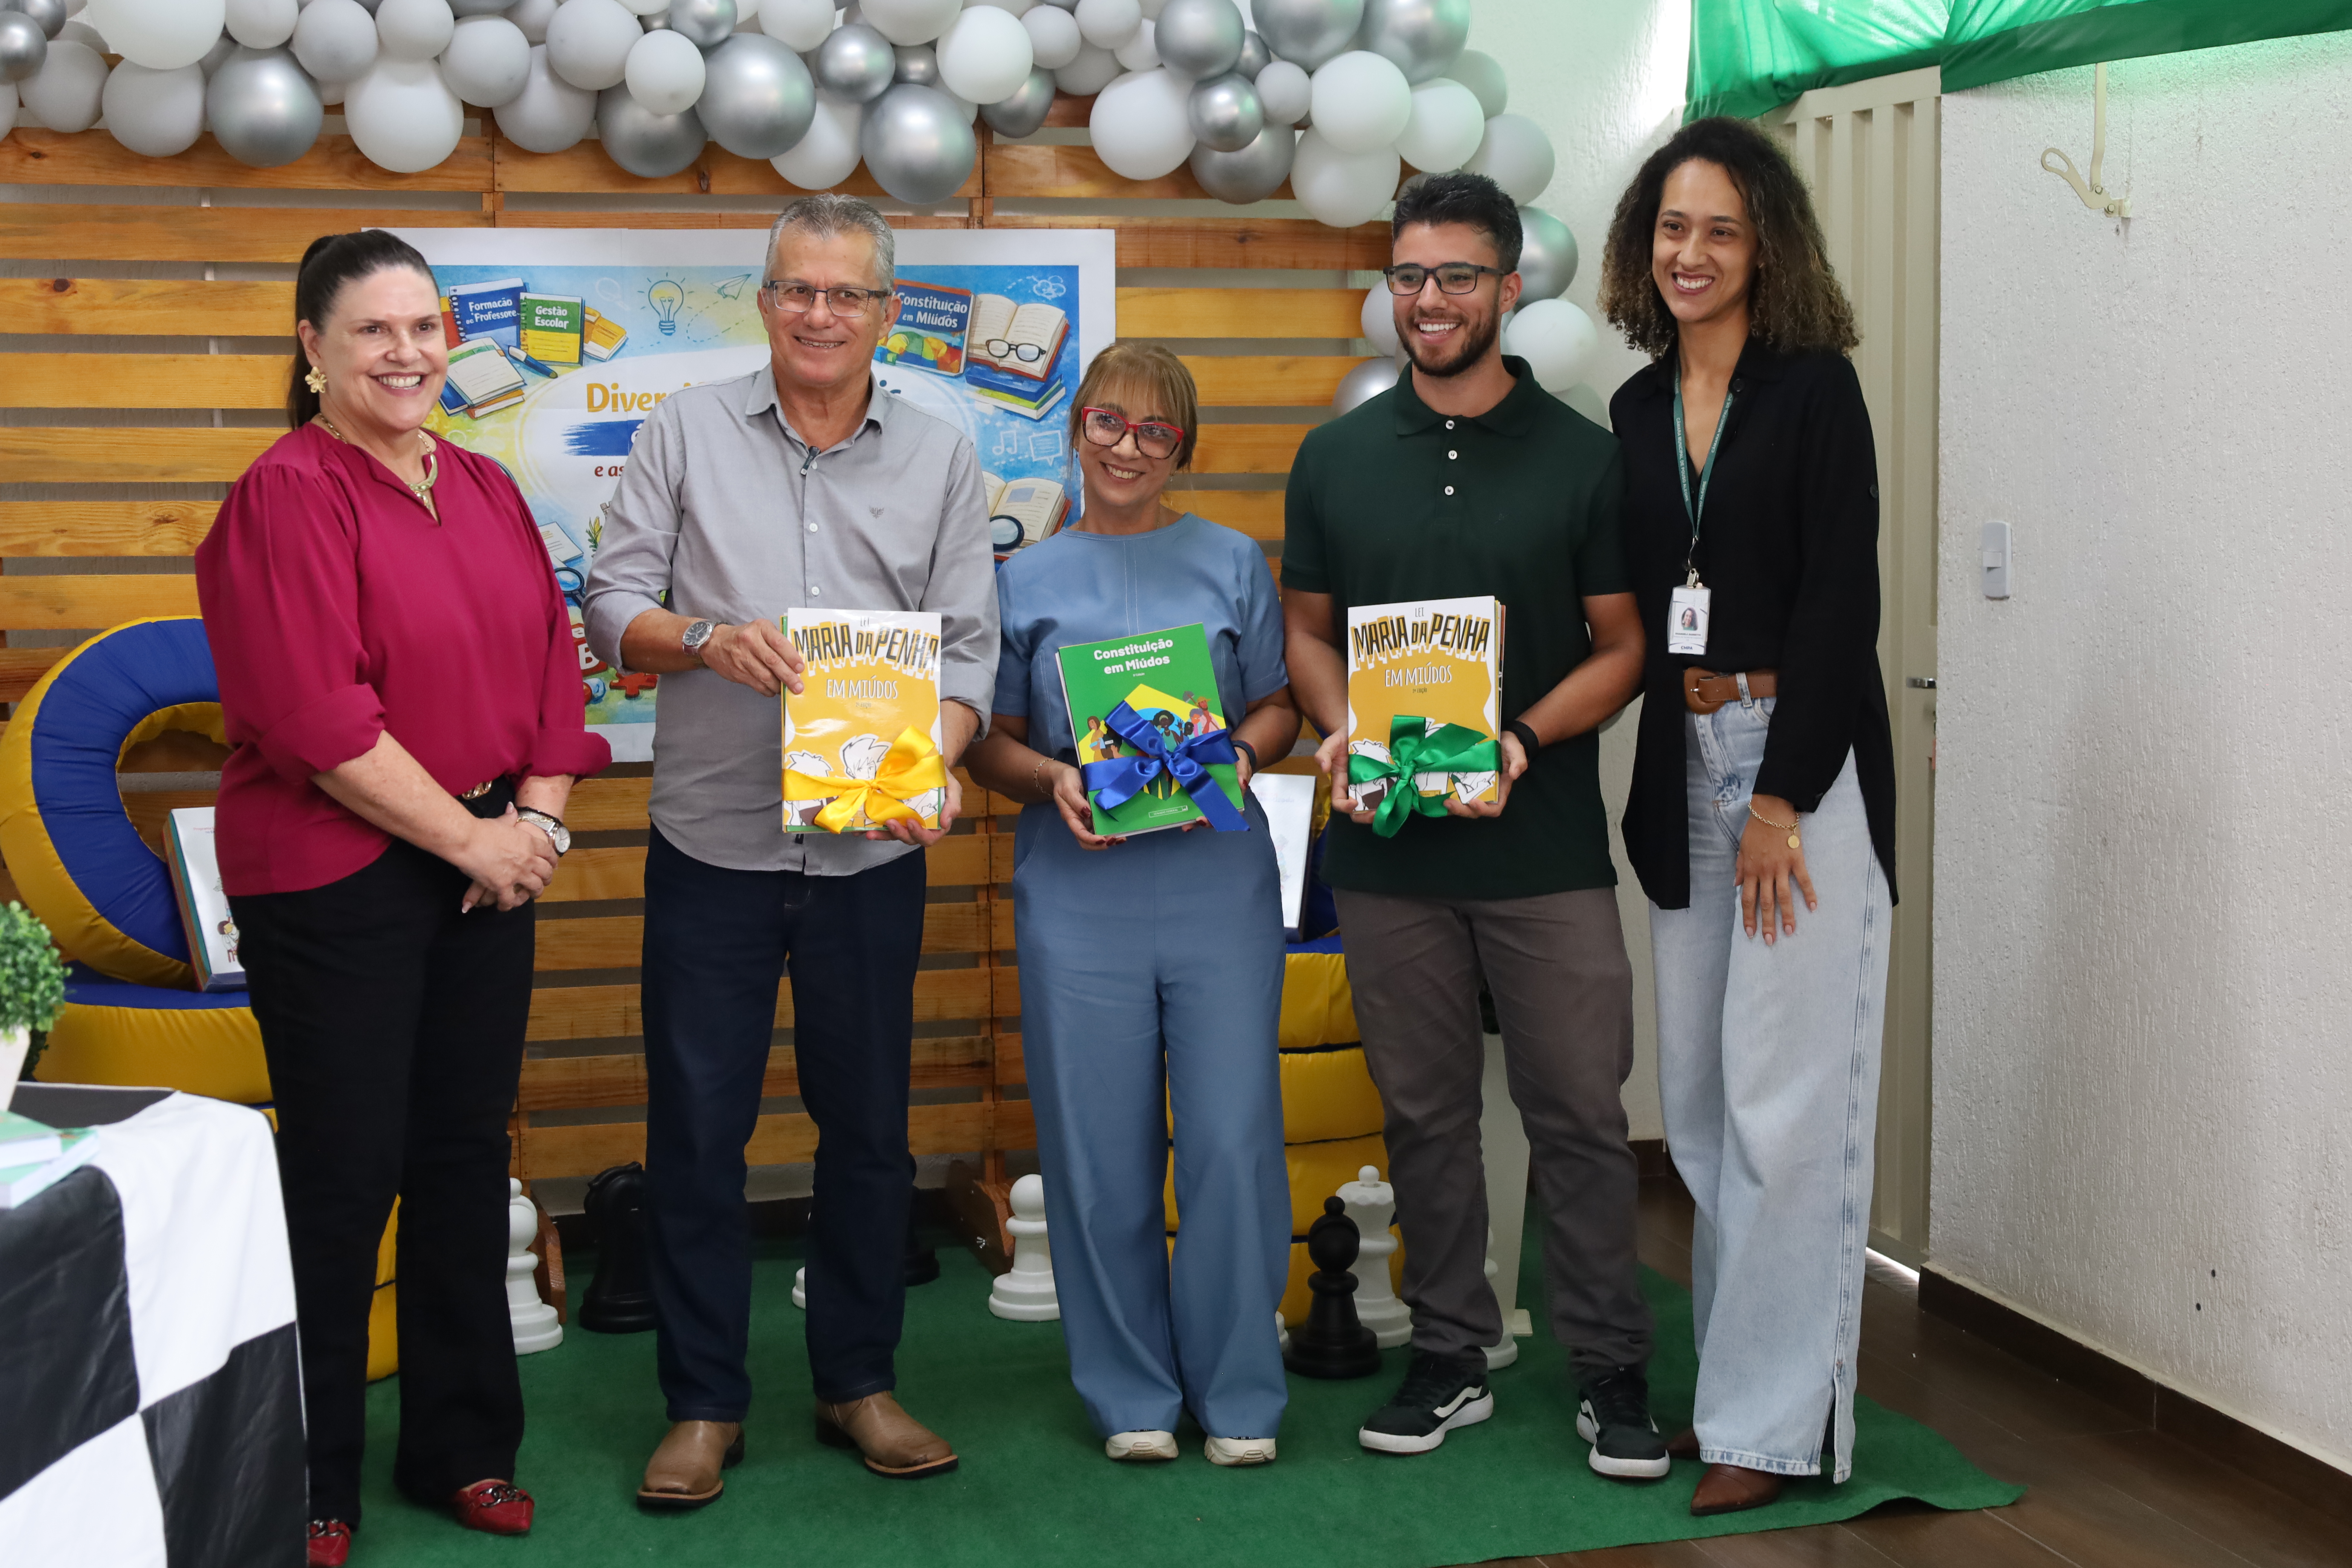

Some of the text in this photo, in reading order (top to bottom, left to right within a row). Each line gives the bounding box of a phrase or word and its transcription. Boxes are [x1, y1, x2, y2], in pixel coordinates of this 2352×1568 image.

[534, 316, 569, 329] Escolar
[902, 313, 913, 322] em
[1711, 433, 1720, 453] CÂMARA
[1717, 409, 1728, 433] MUNICIPAL
[594, 466, 603, 477] e
[1415, 607, 1424, 617] LEI
[793, 623, 939, 672] MARIA DA PENHA
[1353, 613, 1490, 660] MARIA DA PENHA
[577, 643, 600, 670] B
[1094, 639, 1173, 660] Constituição
[1104, 656, 1170, 674] em Miúdos
[1385, 662, 1452, 687] EM MIÚDOS
[826, 675, 899, 699] EM MIÚDOS
